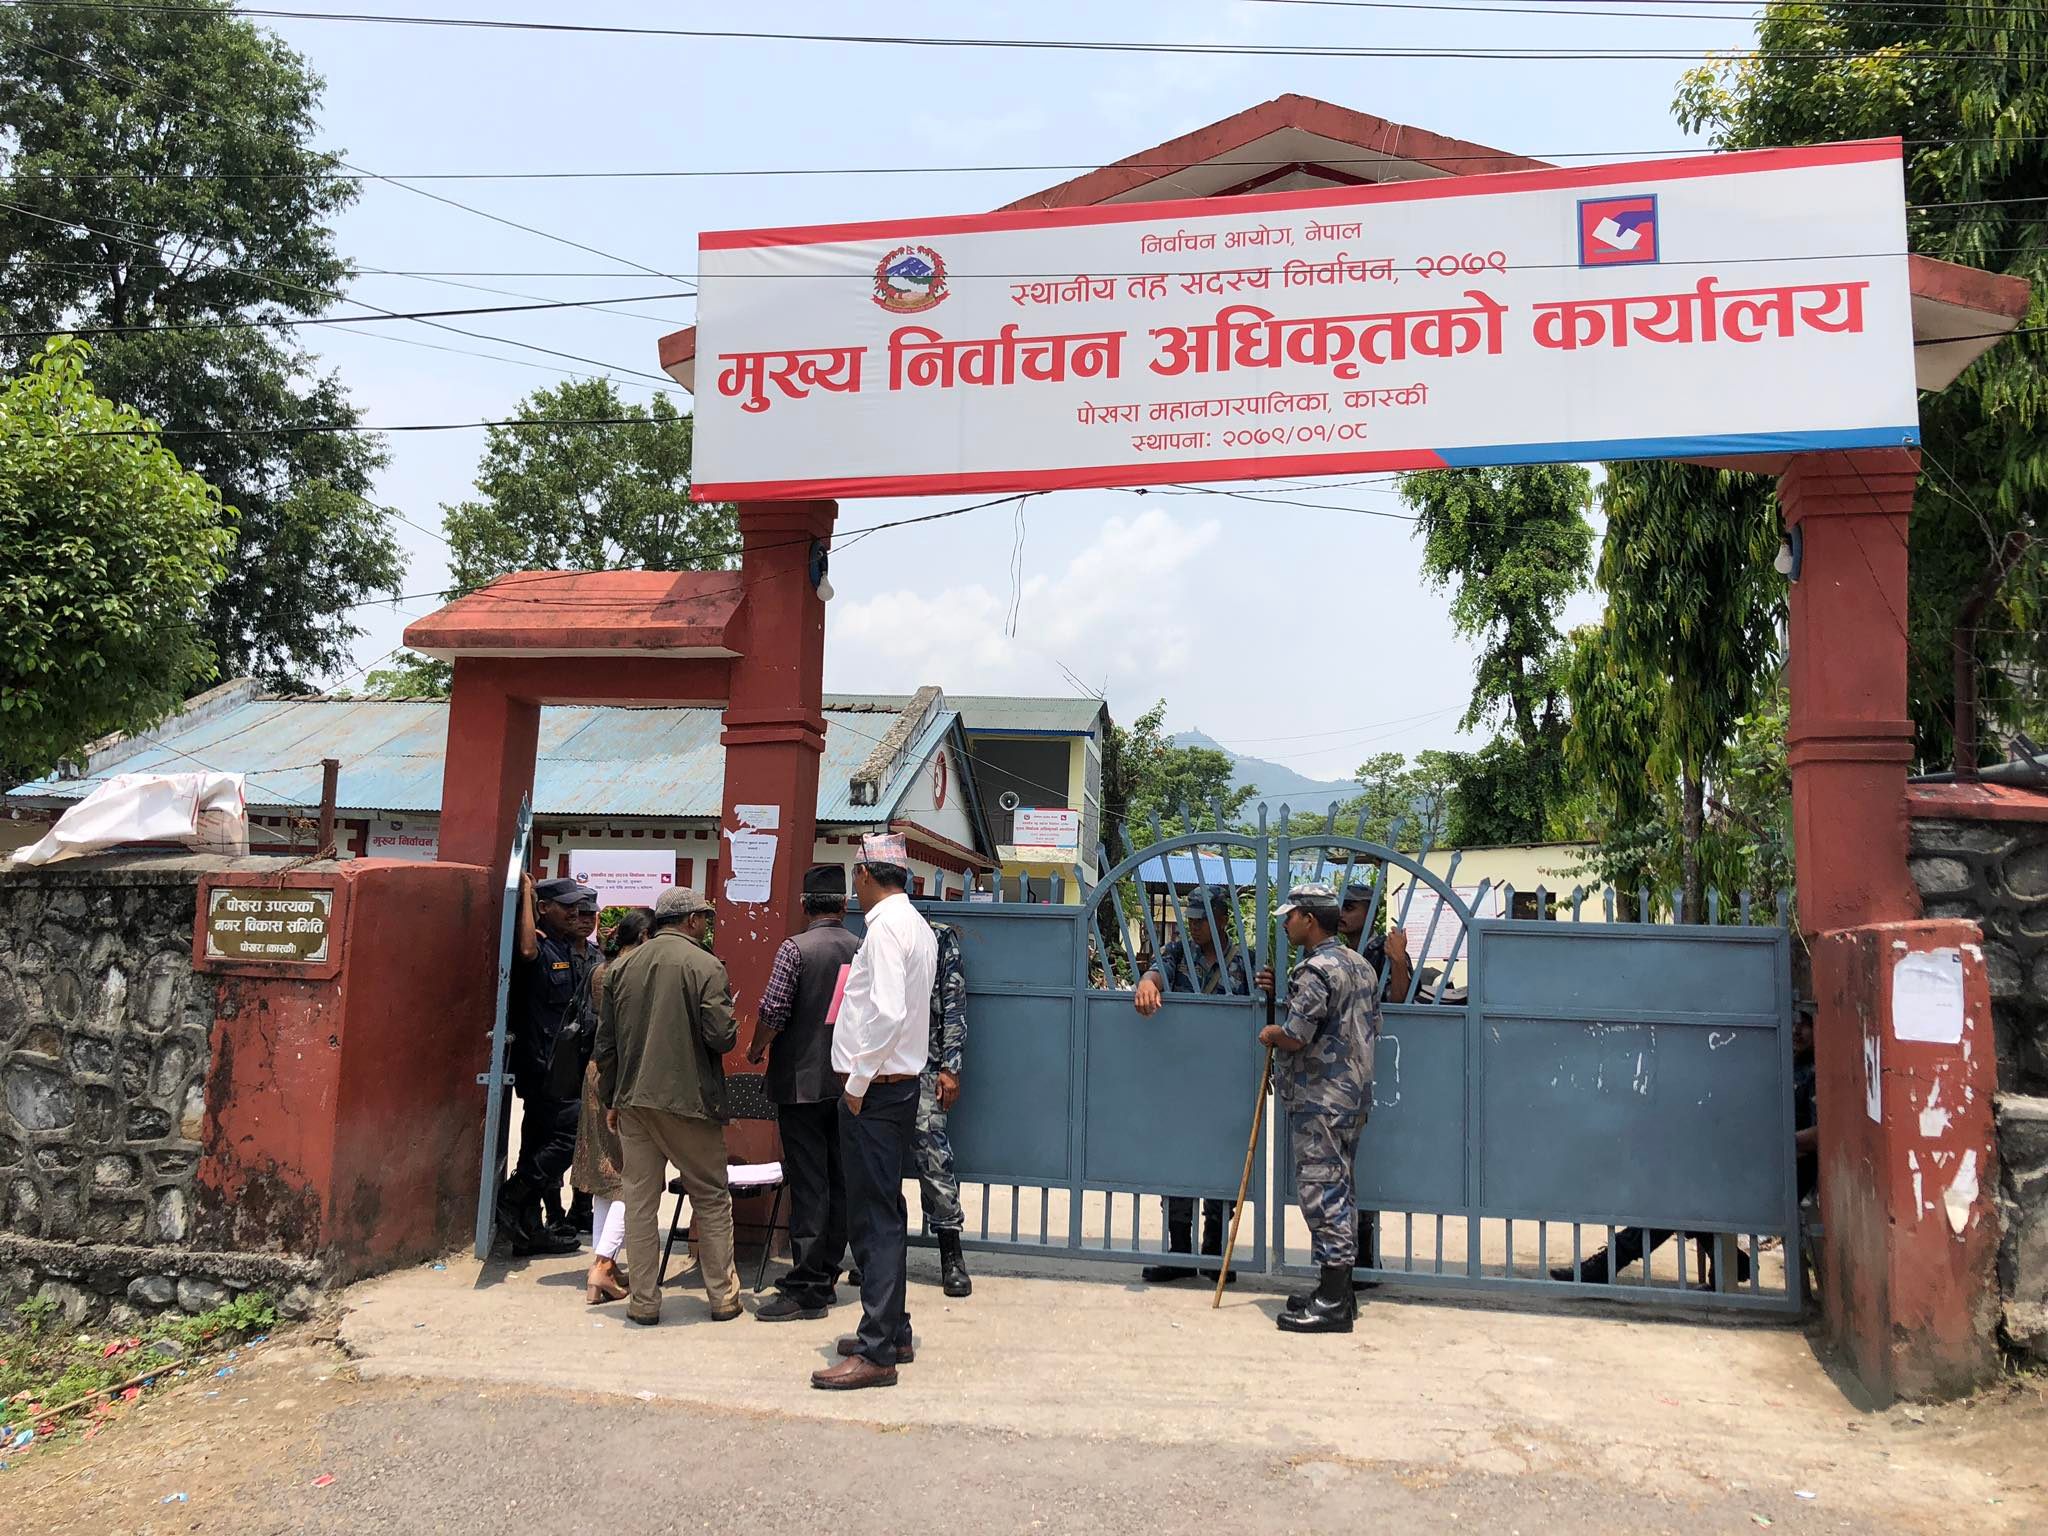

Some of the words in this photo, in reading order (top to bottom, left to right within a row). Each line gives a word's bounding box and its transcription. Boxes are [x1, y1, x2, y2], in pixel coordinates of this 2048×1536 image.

[1141, 229, 1217, 255] निर्वाचन
[1224, 224, 1296, 252] आयोग,
[1304, 220, 1363, 242] नेपाल
[1010, 274, 1117, 306] स्थानीय
[1127, 274, 1169, 301] तह
[1179, 267, 1273, 295] सदस्य
[1283, 251, 1399, 288] निर्वाचन,
[1415, 250, 1507, 279] २०७९
[718, 346, 867, 413] मुख्य
[888, 324, 1127, 392] निर्वाचन
[1148, 289, 1509, 380] अधिकृतको
[1531, 276, 1870, 351] कार्यालय
[1077, 400, 1141, 425] पोखरा
[1149, 391, 1333, 422] महानगरपालिका,
[1344, 382, 1429, 408] कास्की
[1131, 430, 1212, 452] स्थापना:
[1222, 422, 1368, 447] २०७९/०१/०८
[226, 897, 263, 912] पोखरा
[265, 899, 315, 913] उपत्यका
[215, 919, 243, 932] नगर
[245, 917, 284, 932] विकास
[287, 917, 325, 934] समिति
